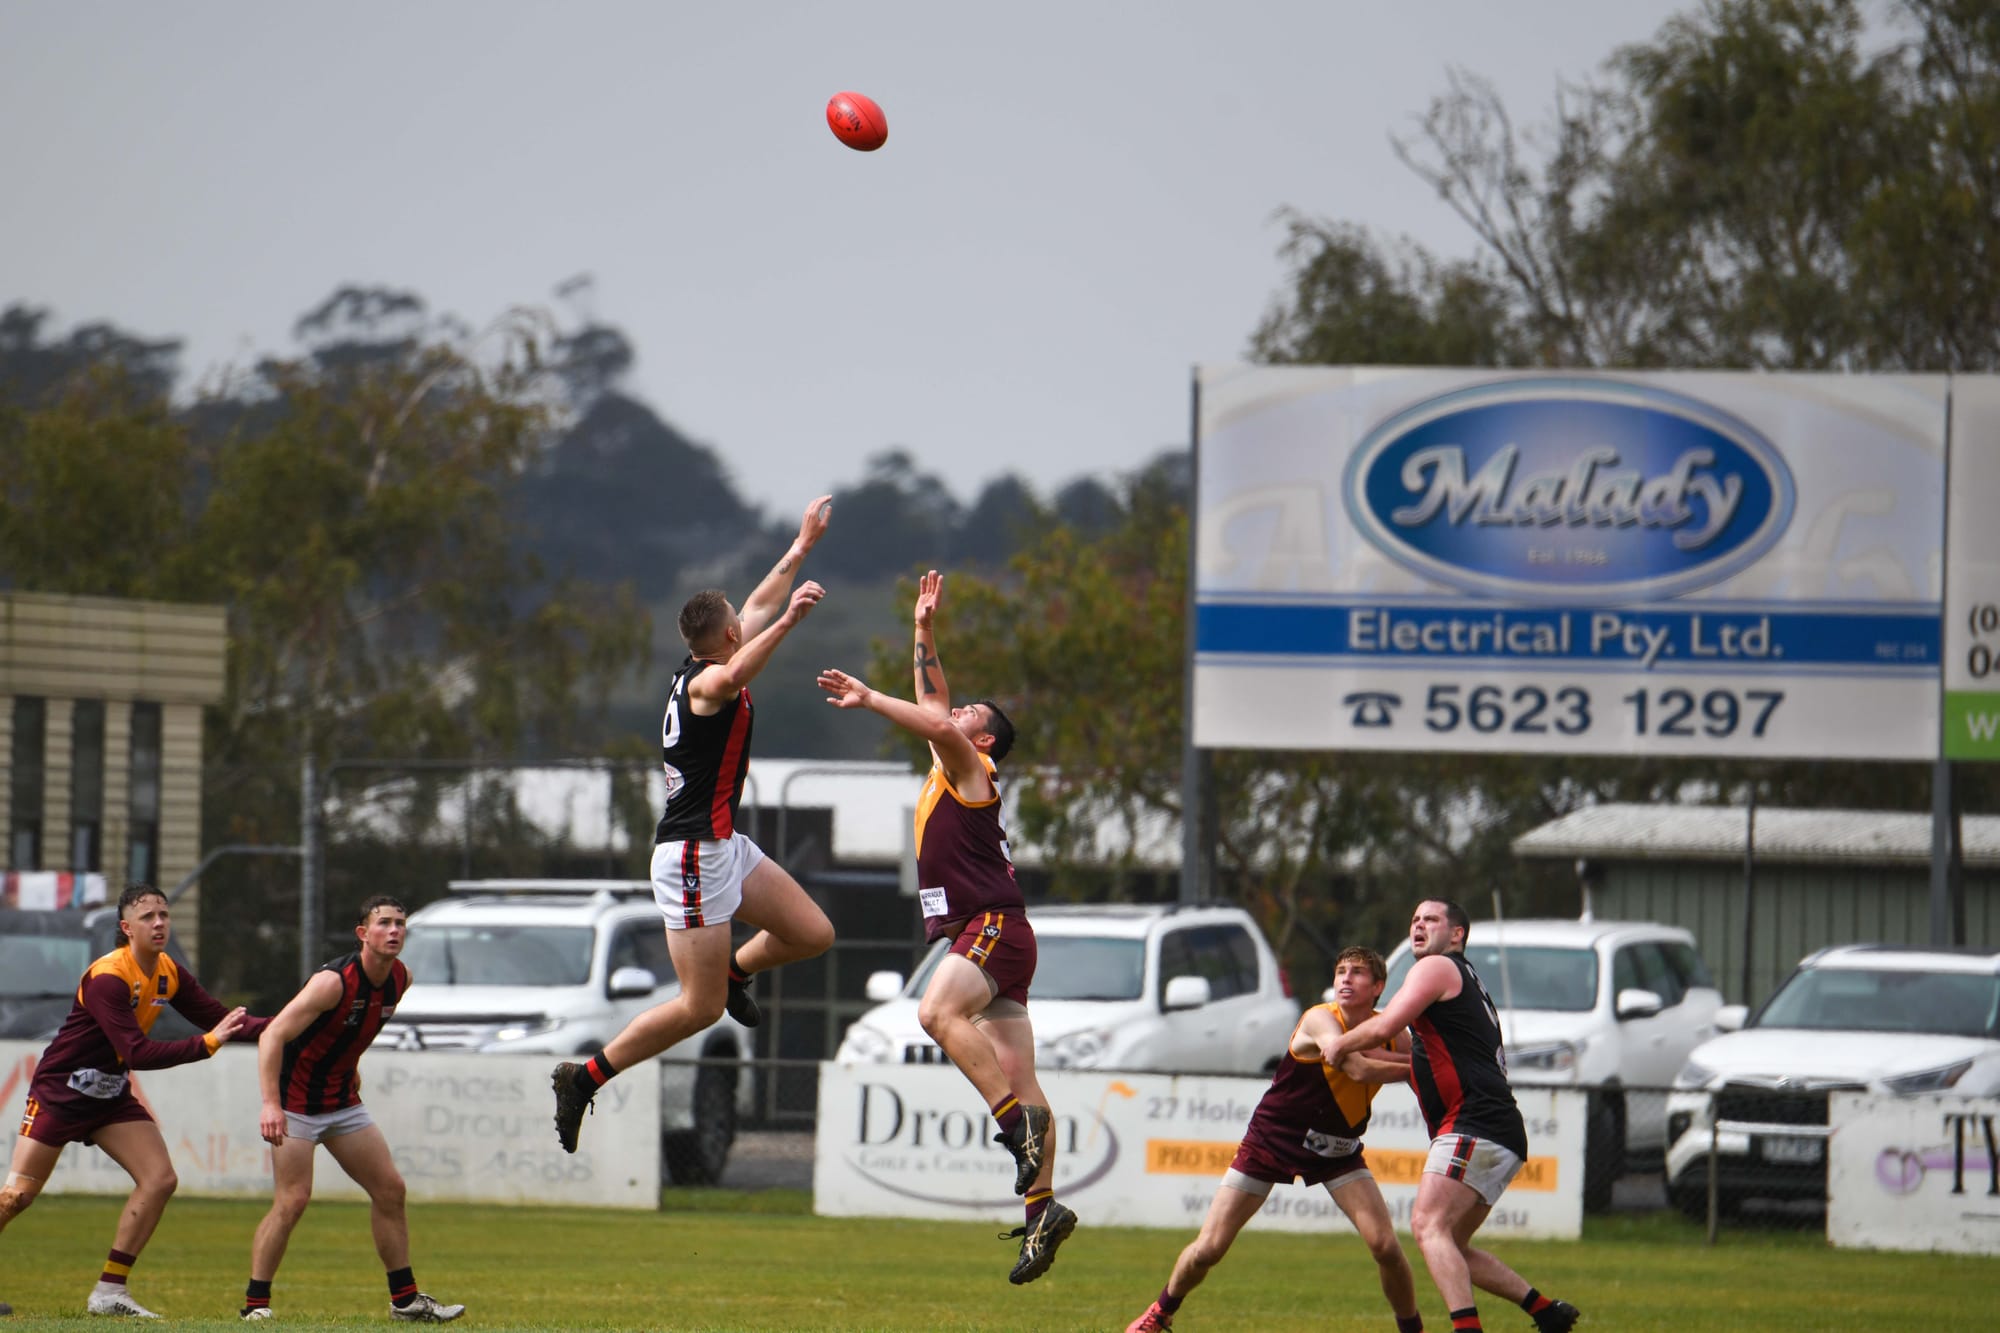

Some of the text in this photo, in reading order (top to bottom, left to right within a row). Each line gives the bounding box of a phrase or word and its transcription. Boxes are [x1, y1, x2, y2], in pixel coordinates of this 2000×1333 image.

[1391, 443, 1742, 551] Malady
[1347, 608, 1783, 669] Electrical Pty. Ltd.
[1424, 685, 1786, 739] 5623 1297
[858, 1083, 1079, 1153] Droun
[1147, 1097, 1179, 1119] 27
